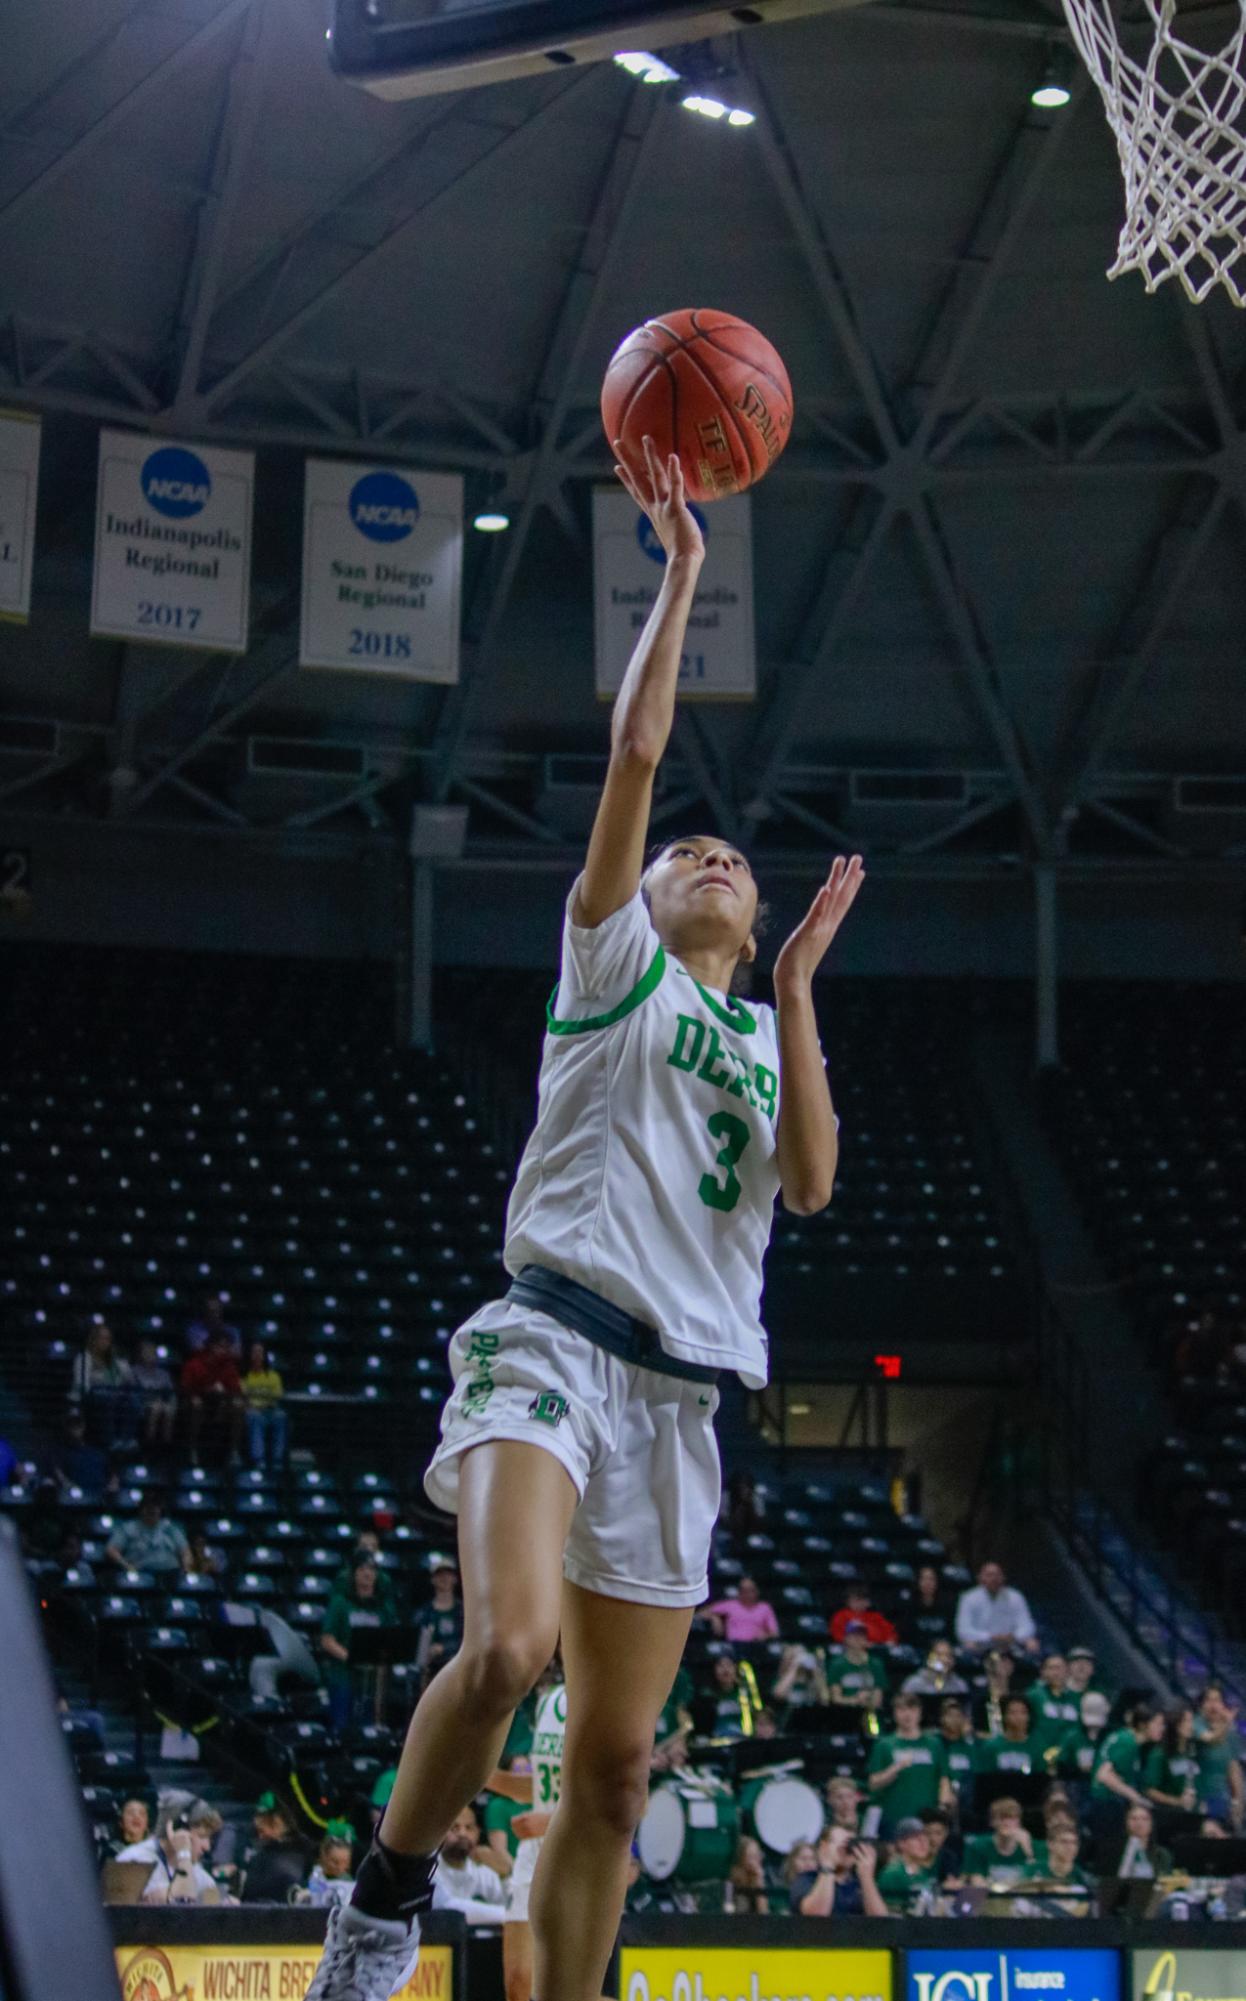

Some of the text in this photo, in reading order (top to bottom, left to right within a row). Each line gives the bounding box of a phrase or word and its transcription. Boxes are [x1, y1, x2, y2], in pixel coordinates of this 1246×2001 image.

[147, 478, 210, 505] NCAA
[355, 504, 417, 528] NCAA
[105, 514, 242, 553] Indianapolis
[125, 546, 221, 581] Regional
[330, 559, 435, 590] San Diego
[337, 583, 427, 610] Regional
[137, 600, 202, 632] 2017
[348, 627, 413, 659] 2018
[698, 1110, 751, 1214] 3
[203, 1960, 272, 2001] WICHITA
